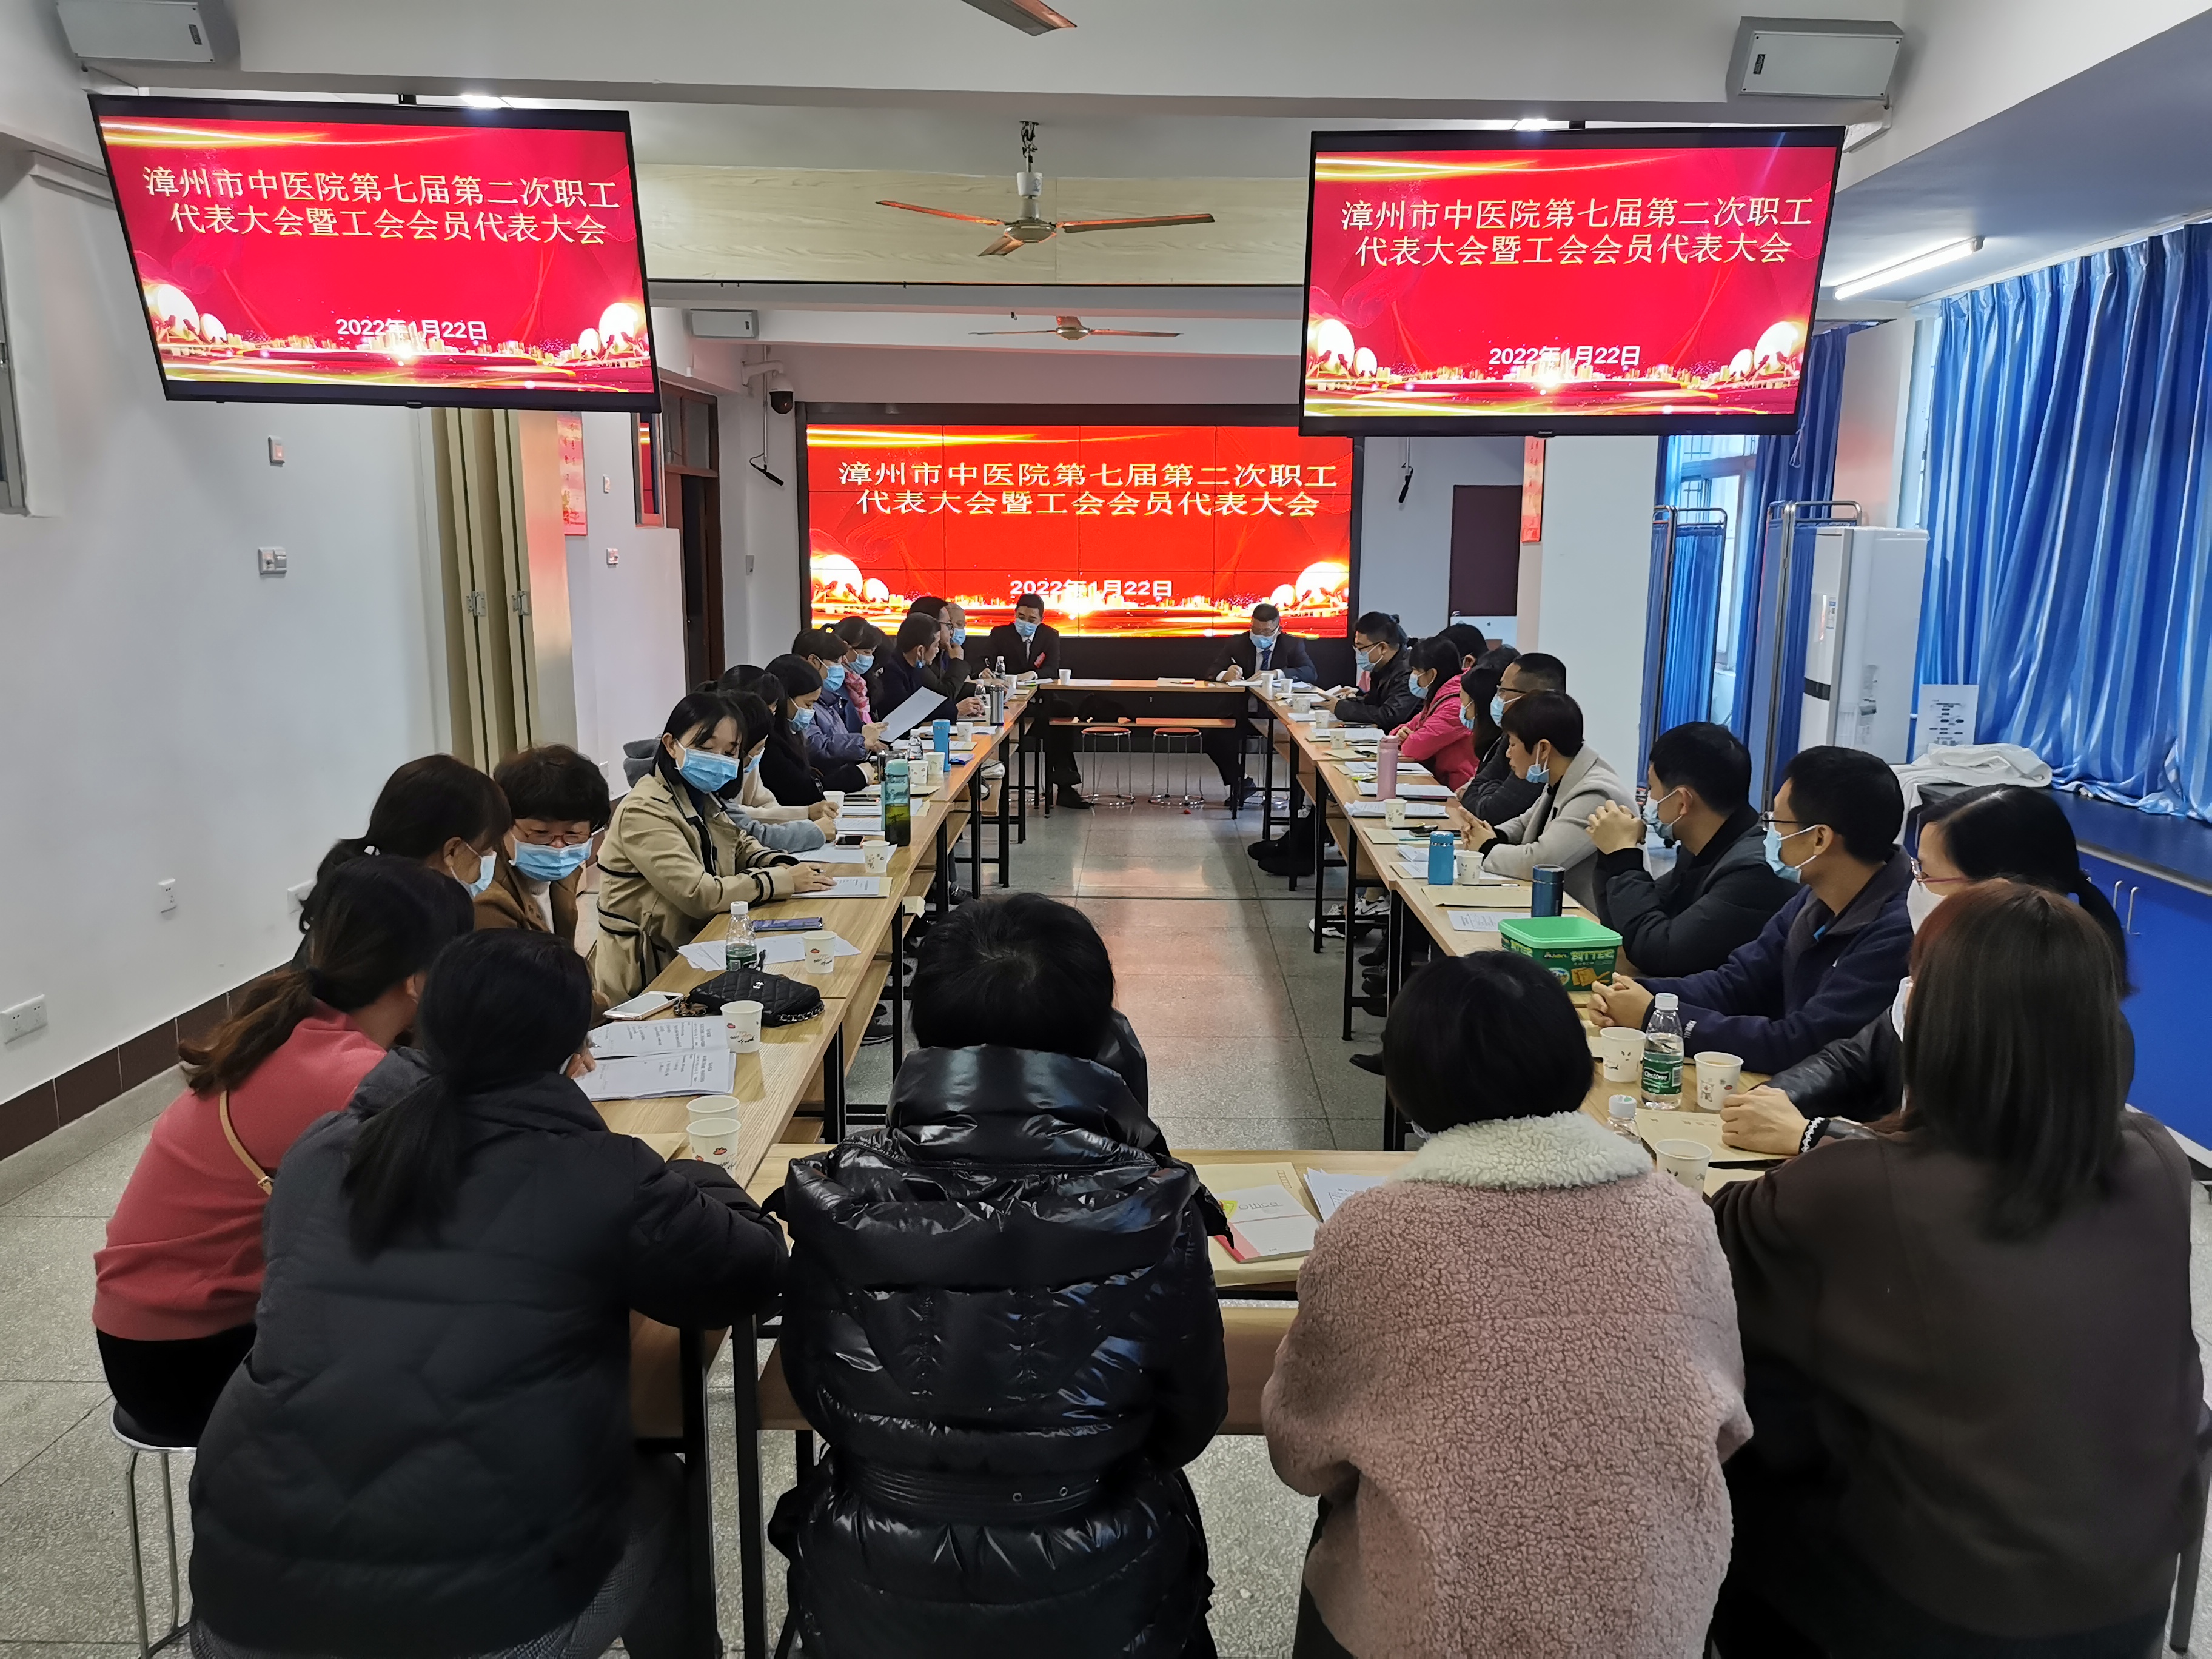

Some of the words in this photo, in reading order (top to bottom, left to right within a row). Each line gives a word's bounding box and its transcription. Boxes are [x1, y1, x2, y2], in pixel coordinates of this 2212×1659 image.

[142, 166, 620, 209] 漳州市中医院第七届第二次职工
[170, 204, 608, 245] 代表大会暨工会会员代表大会
[1340, 197, 1814, 231] 漳州市中医院第七届第二次职工
[1355, 232, 1792, 265] 代表大会暨工会会员代表大会
[335, 318, 488, 341] 2022年1月22日
[1488, 346, 1640, 368] 2022年1月22日
[838, 461, 1338, 488] 漳州市中医院第七届第二次职工
[856, 491, 1320, 518] 代表大会暨工会会员代表大会
[1010, 578, 1172, 597] 2022年1月22日
[1570, 948, 1615, 962] BITTER
